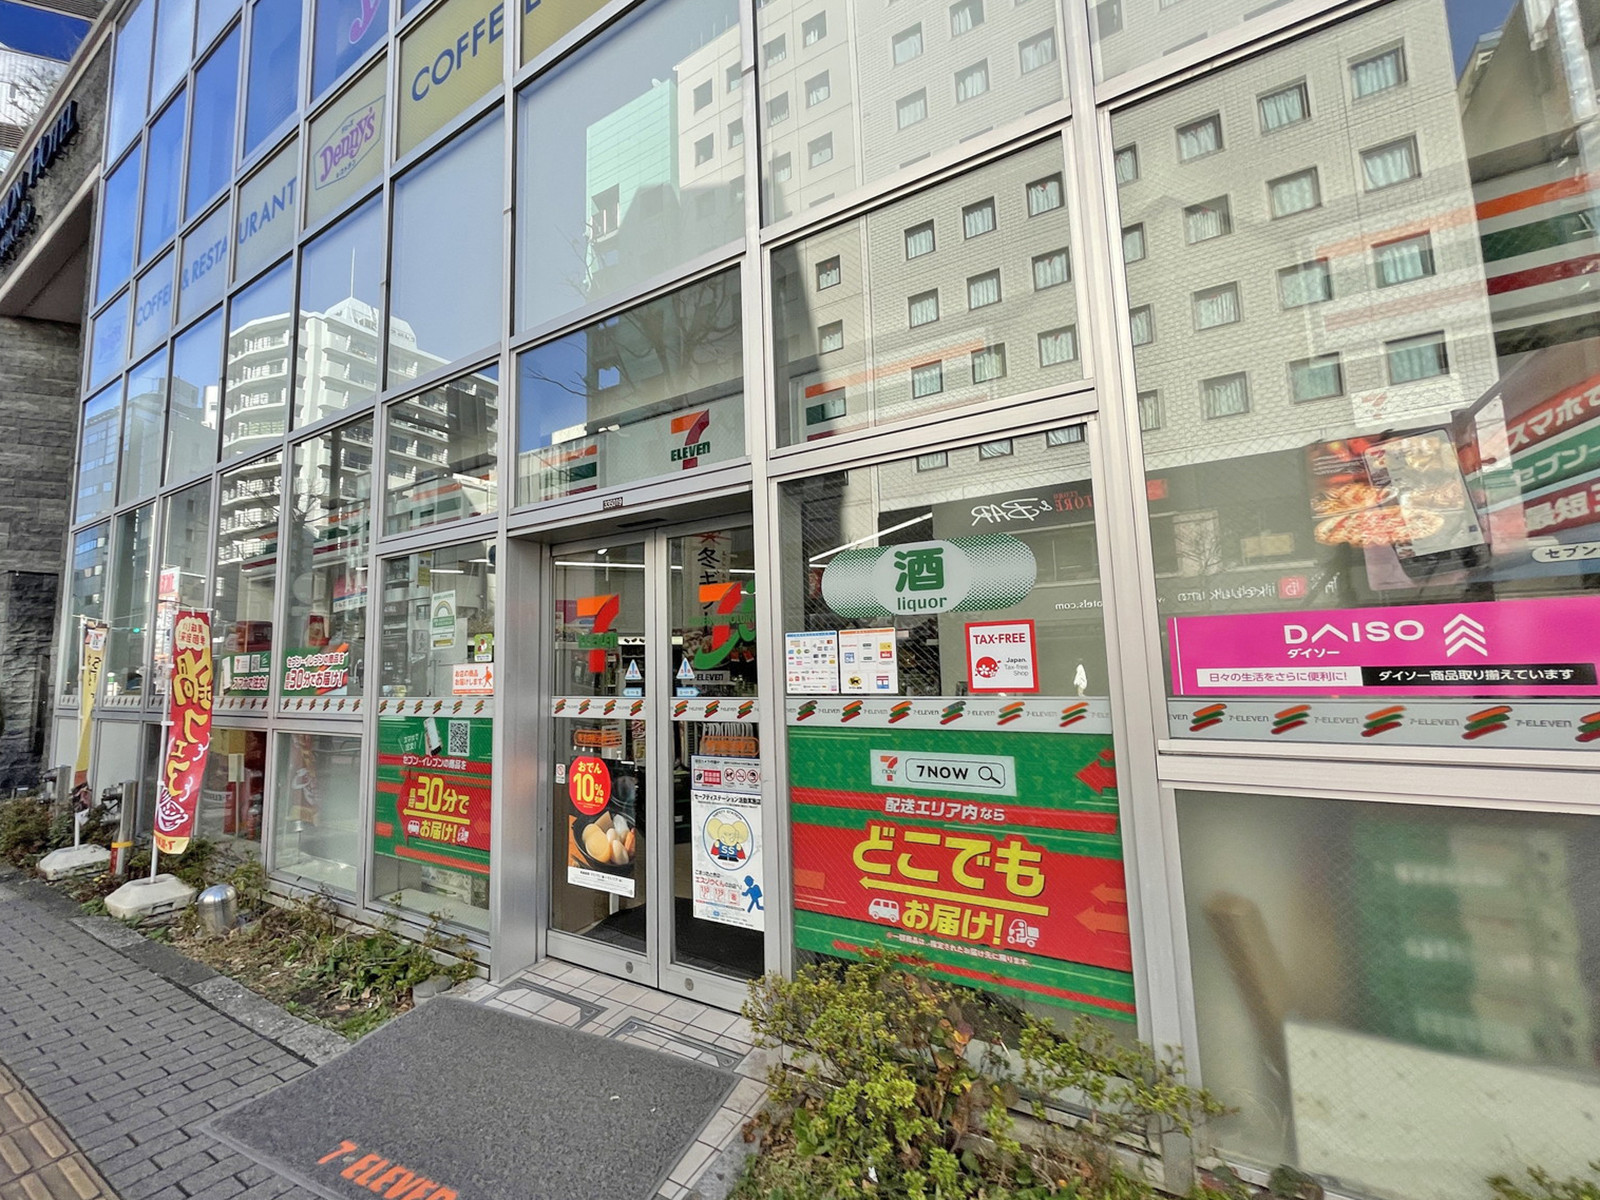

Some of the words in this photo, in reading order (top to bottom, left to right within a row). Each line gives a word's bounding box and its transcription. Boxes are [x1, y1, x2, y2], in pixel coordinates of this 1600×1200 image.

[320, 106, 375, 182] Denny's
[894, 547, 945, 592] 酒
[896, 596, 948, 612] liquor
[973, 632, 1026, 645] TAX-FREE
[1283, 620, 1425, 644] DAISO
[1287, 648, 1340, 658] ダイソー
[1209, 671, 1347, 682] 日々の生活をさらに便利に!
[1378, 668, 1574, 681] ダイソー商品取り揃えています
[577, 761, 602, 774] おでん
[916, 765, 969, 780] 7NOW
[885, 797, 1005, 821] 配送エリア内なら
[420, 819, 458, 843] お届け!
[721, 845, 735, 854] SS
[853, 825, 1045, 897] どこでも
[901, 899, 1005, 945] お届け!
